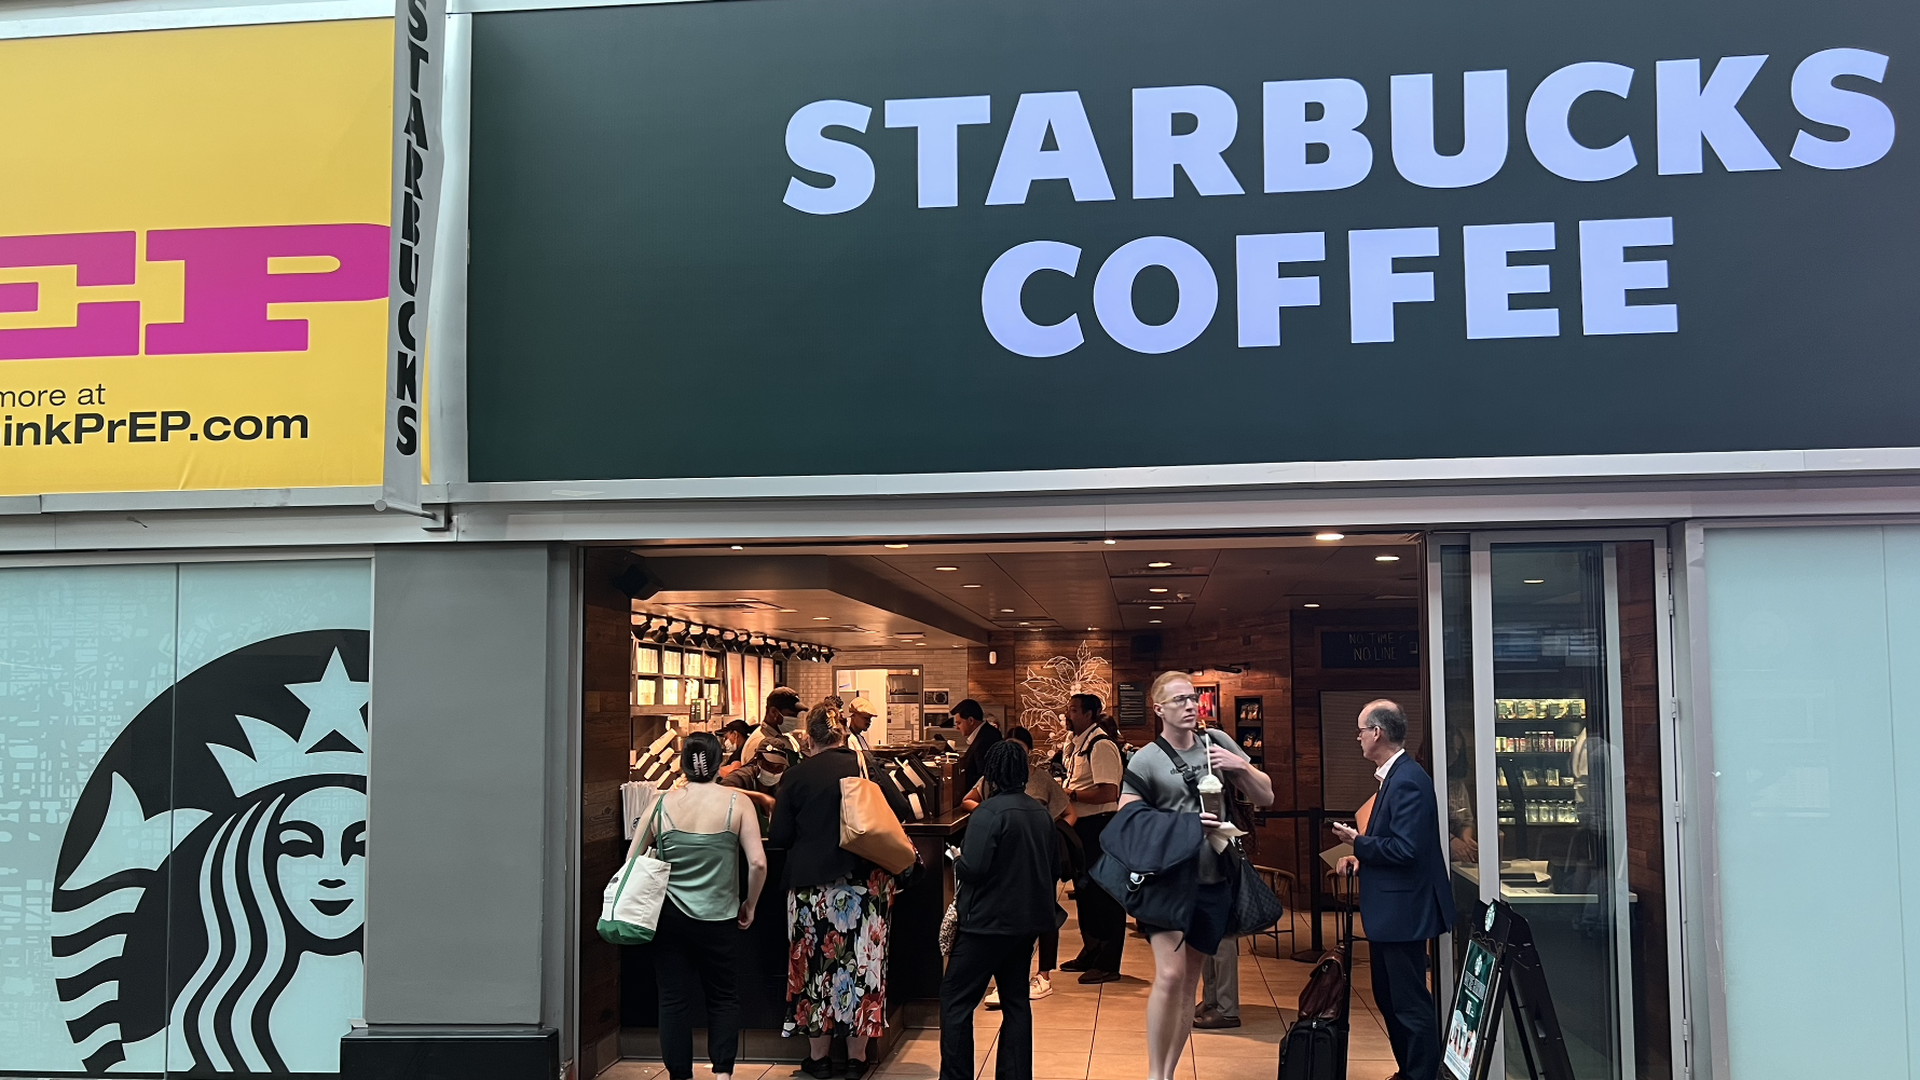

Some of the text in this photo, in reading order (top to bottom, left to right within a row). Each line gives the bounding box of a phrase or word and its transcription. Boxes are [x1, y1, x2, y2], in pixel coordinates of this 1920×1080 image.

[782, 47, 1896, 215] STARBUCKS
[396, 0, 429, 456] STARBUCKS
[981, 216, 1679, 358] COFFEE
[77, 383, 106, 405] at
[4, 410, 309, 446] inkPrEP.com
[1348, 633, 1364, 644] NO
[1353, 646, 1397, 661] NO LINE
